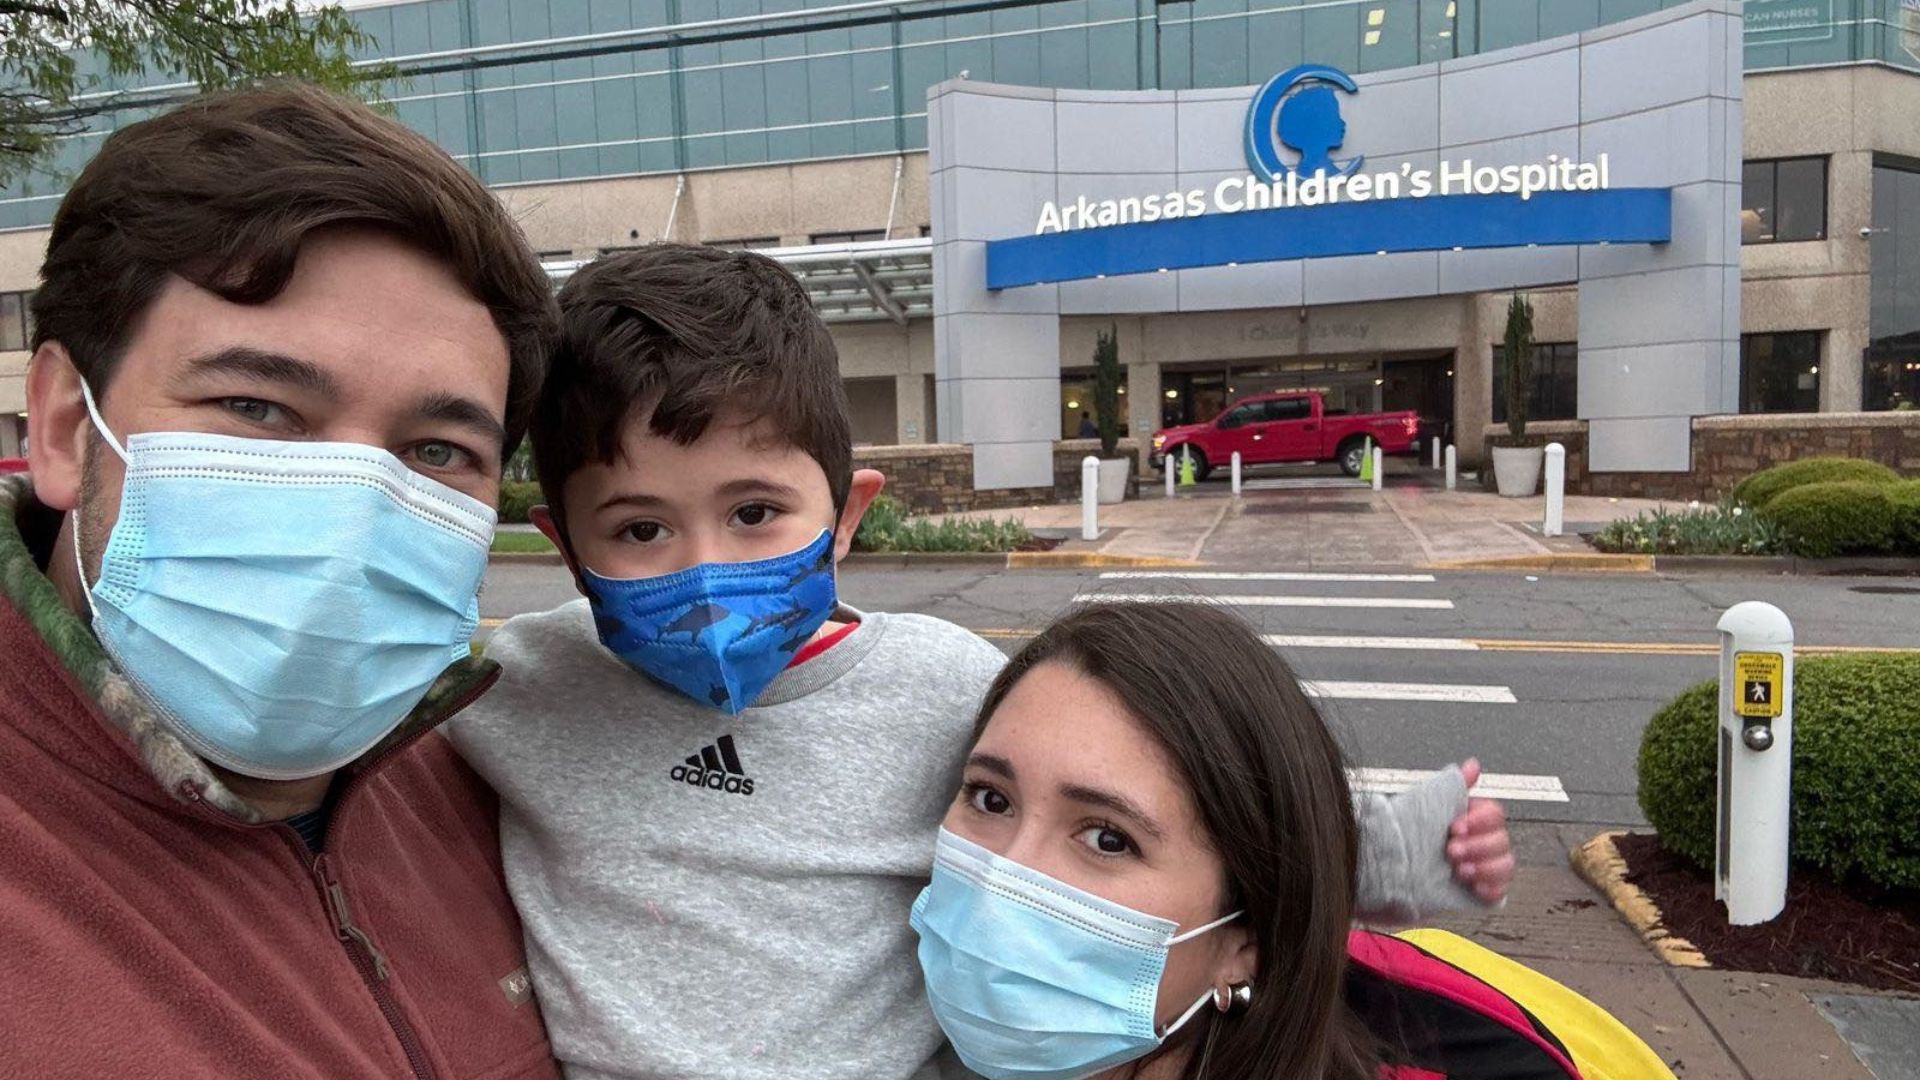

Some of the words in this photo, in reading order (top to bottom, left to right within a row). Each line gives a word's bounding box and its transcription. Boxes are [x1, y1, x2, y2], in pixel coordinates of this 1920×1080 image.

[1035, 189, 1207, 235] Arkansas
[1213, 161, 1433, 213] Children's
[1439, 152, 1610, 201] Hospital
[670, 765, 755, 796] adidas
